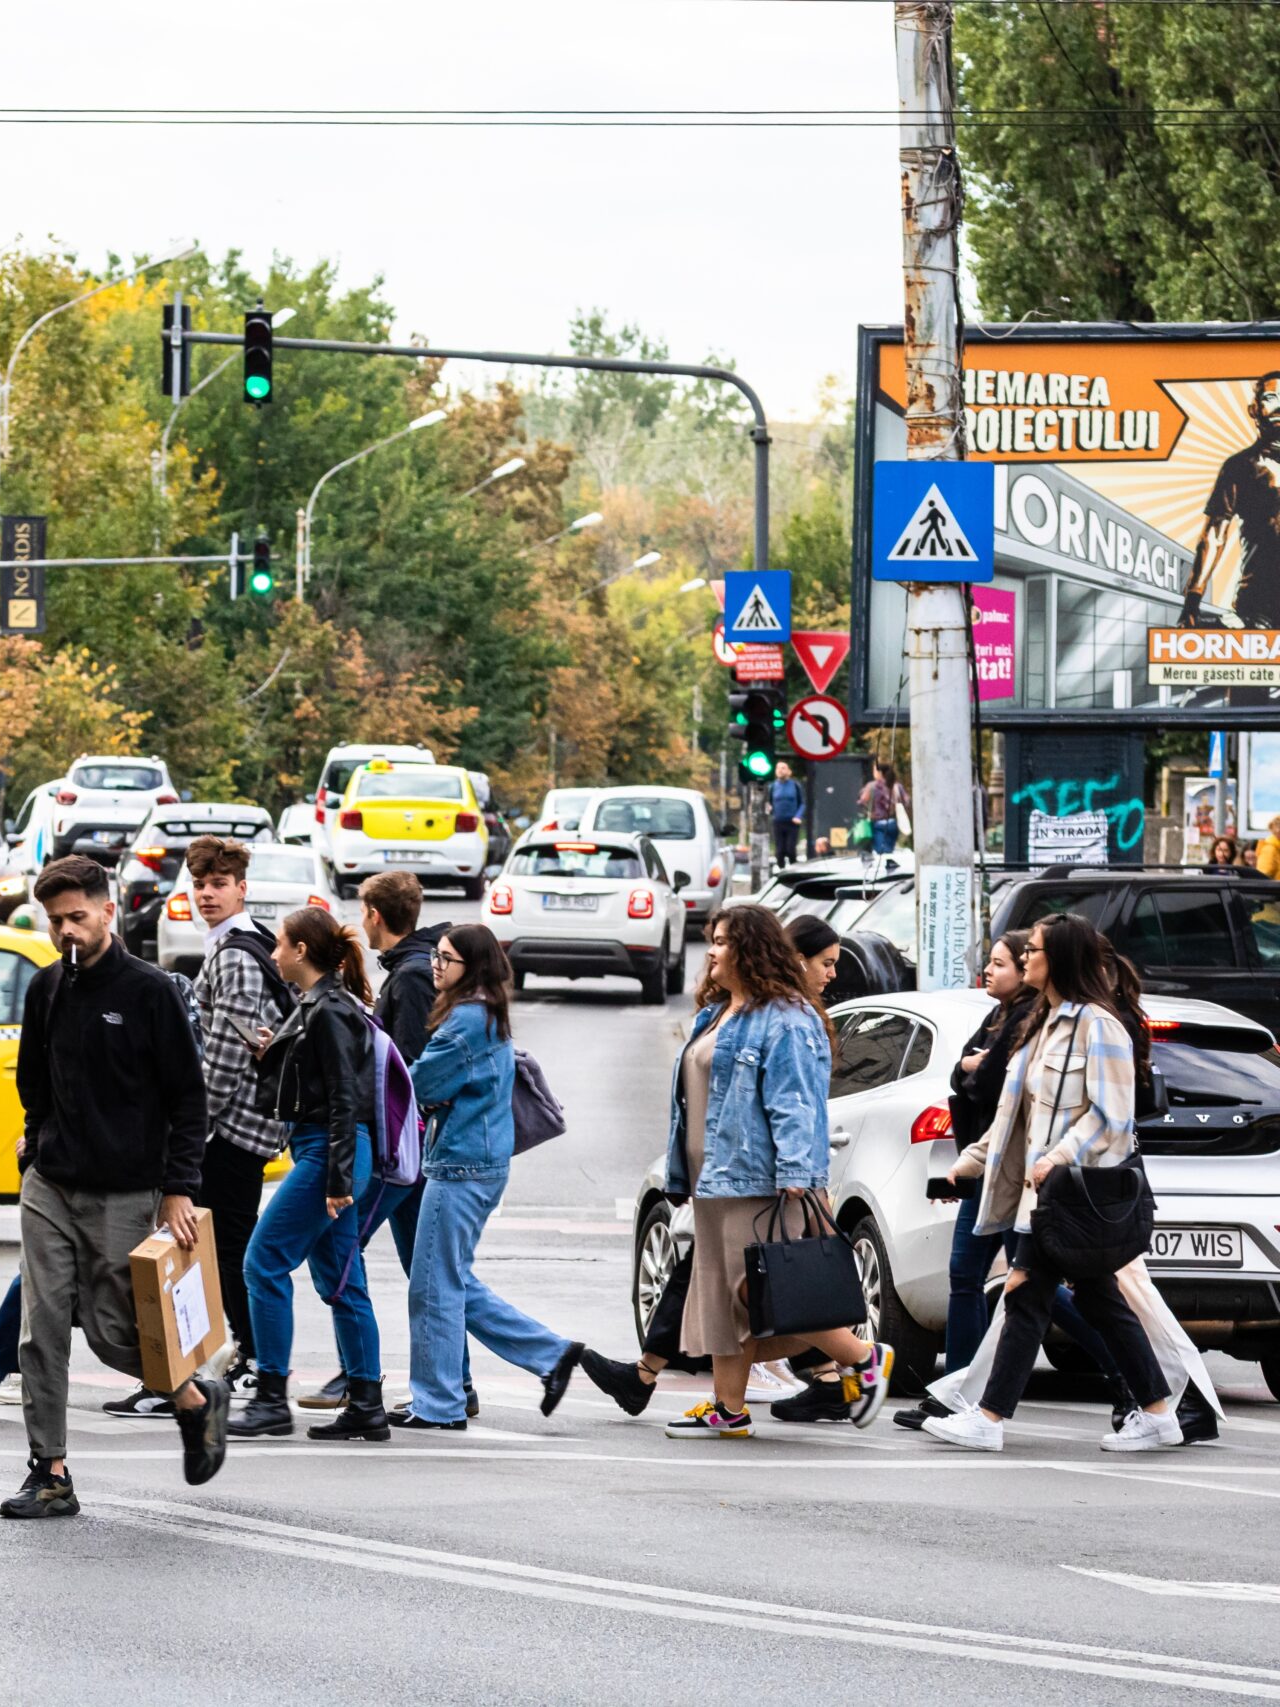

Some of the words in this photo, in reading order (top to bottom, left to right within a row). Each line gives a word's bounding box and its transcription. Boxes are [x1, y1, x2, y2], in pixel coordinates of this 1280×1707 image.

[1163, 667, 1197, 680] Mereu
[954, 872, 967, 921] DREAM
[1149, 1233, 1182, 1256] 07
[1190, 1233, 1233, 1257] WIS
